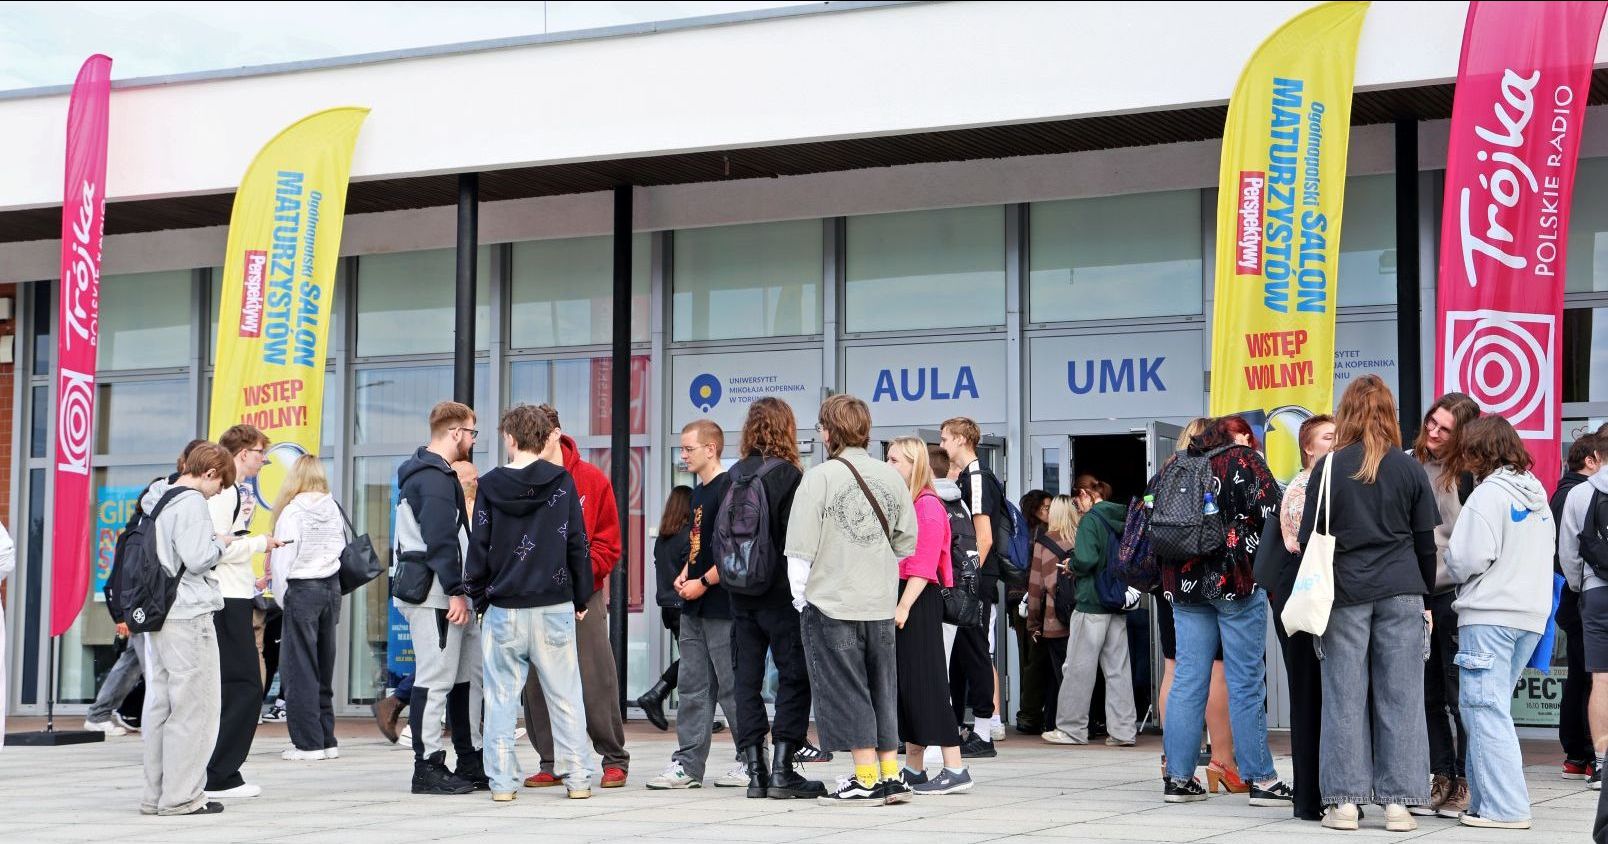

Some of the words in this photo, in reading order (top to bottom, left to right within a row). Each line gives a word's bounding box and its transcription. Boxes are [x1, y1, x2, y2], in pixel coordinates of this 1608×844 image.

[1303, 101, 1325, 206] Ogólnopolski
[1547, 85, 1573, 167] RADIO
[1263, 77, 1304, 313] MATURZYSTÓW
[1460, 68, 1541, 287] Trójka
[65, 180, 96, 351] Trójka
[302, 190, 322, 278] Ogólnopolski
[1238, 177, 1264, 270] Perspektywy
[1296, 210, 1328, 313] SALON
[1535, 177, 1560, 276] POLSKIE
[241, 255, 266, 333] Perspektywy
[263, 170, 304, 366] MATURZYSTÓW
[293, 280, 321, 368] SALON
[1245, 329, 1308, 359] WSTĘP
[1346, 360, 1395, 368] KOPERNIKA
[243, 379, 304, 406] WSTĘP
[729, 376, 778, 384] UNIWERSYTET
[729, 386, 763, 394] MIKOŁAJA
[765, 384, 806, 393] KOPERNIKA
[872, 365, 980, 403] AULA
[1067, 356, 1167, 395] UMK
[1244, 361, 1314, 390] WOLNY!
